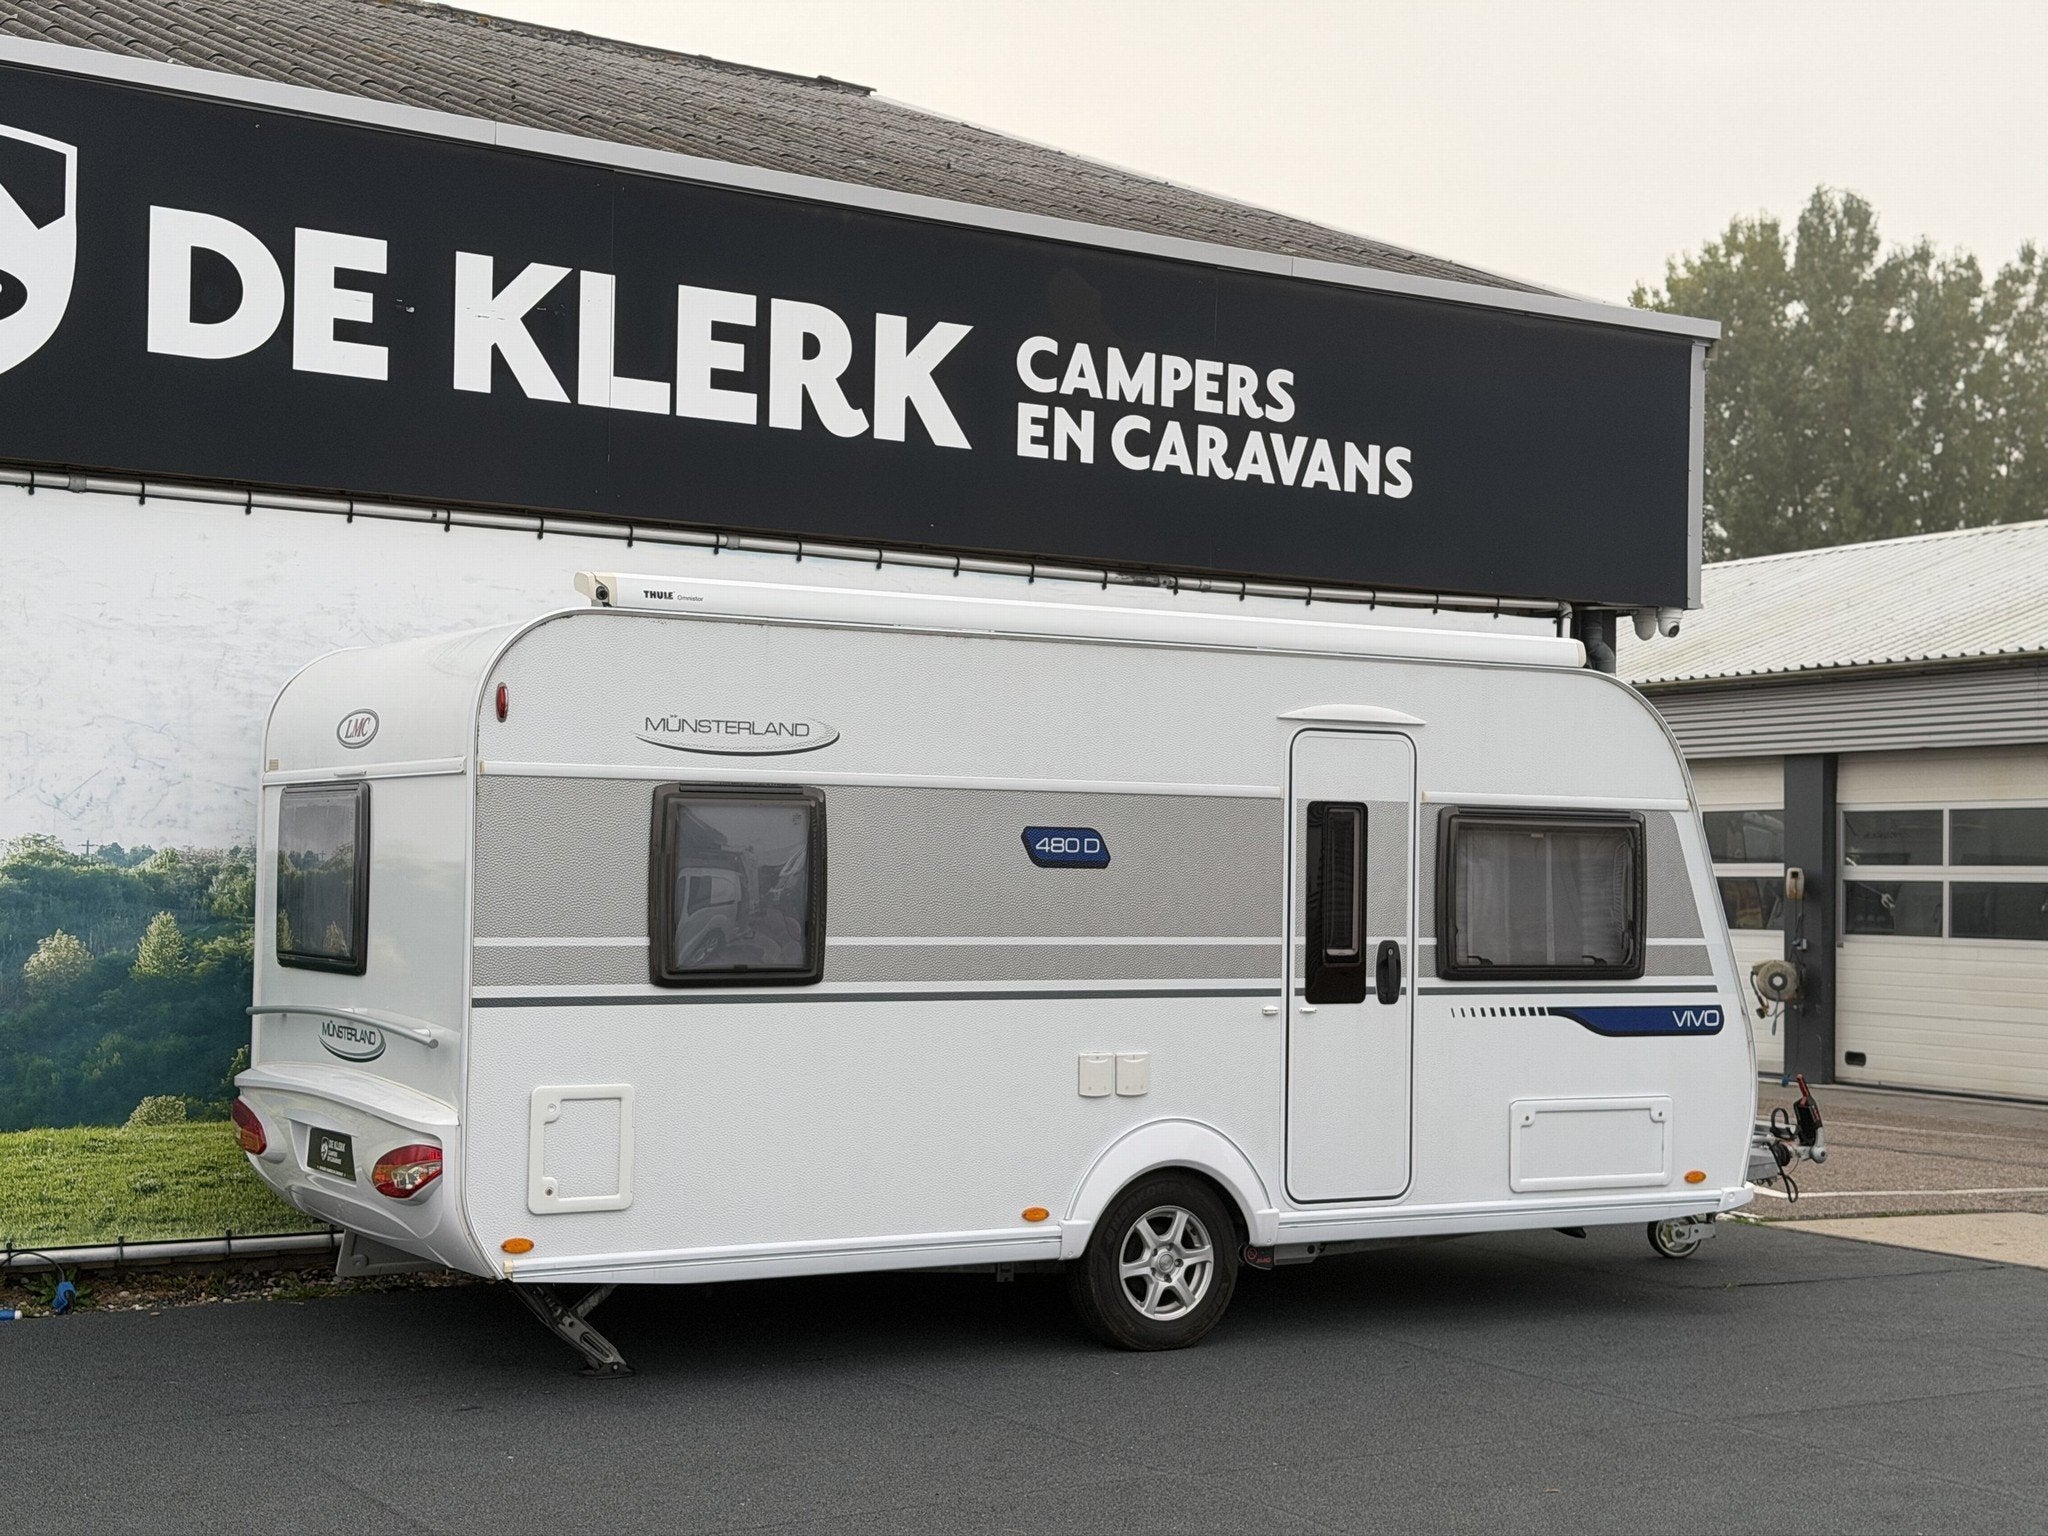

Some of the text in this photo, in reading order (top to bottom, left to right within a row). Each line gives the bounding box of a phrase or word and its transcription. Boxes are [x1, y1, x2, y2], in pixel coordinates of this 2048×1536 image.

[147, 204, 974, 450] DE KLERK
[1016, 335, 1296, 423] CAMPERS
[1016, 401, 1413, 499] EN CARAVANS
[643, 590, 674, 600] THULE
[344, 717, 371, 738] LMC
[645, 714, 810, 737] MÜNSTERLAND
[1035, 837, 1100, 853] 480 D
[1672, 1009, 1720, 1027] VIVO
[321, 1020, 376, 1046] MÜNSTERLAND
